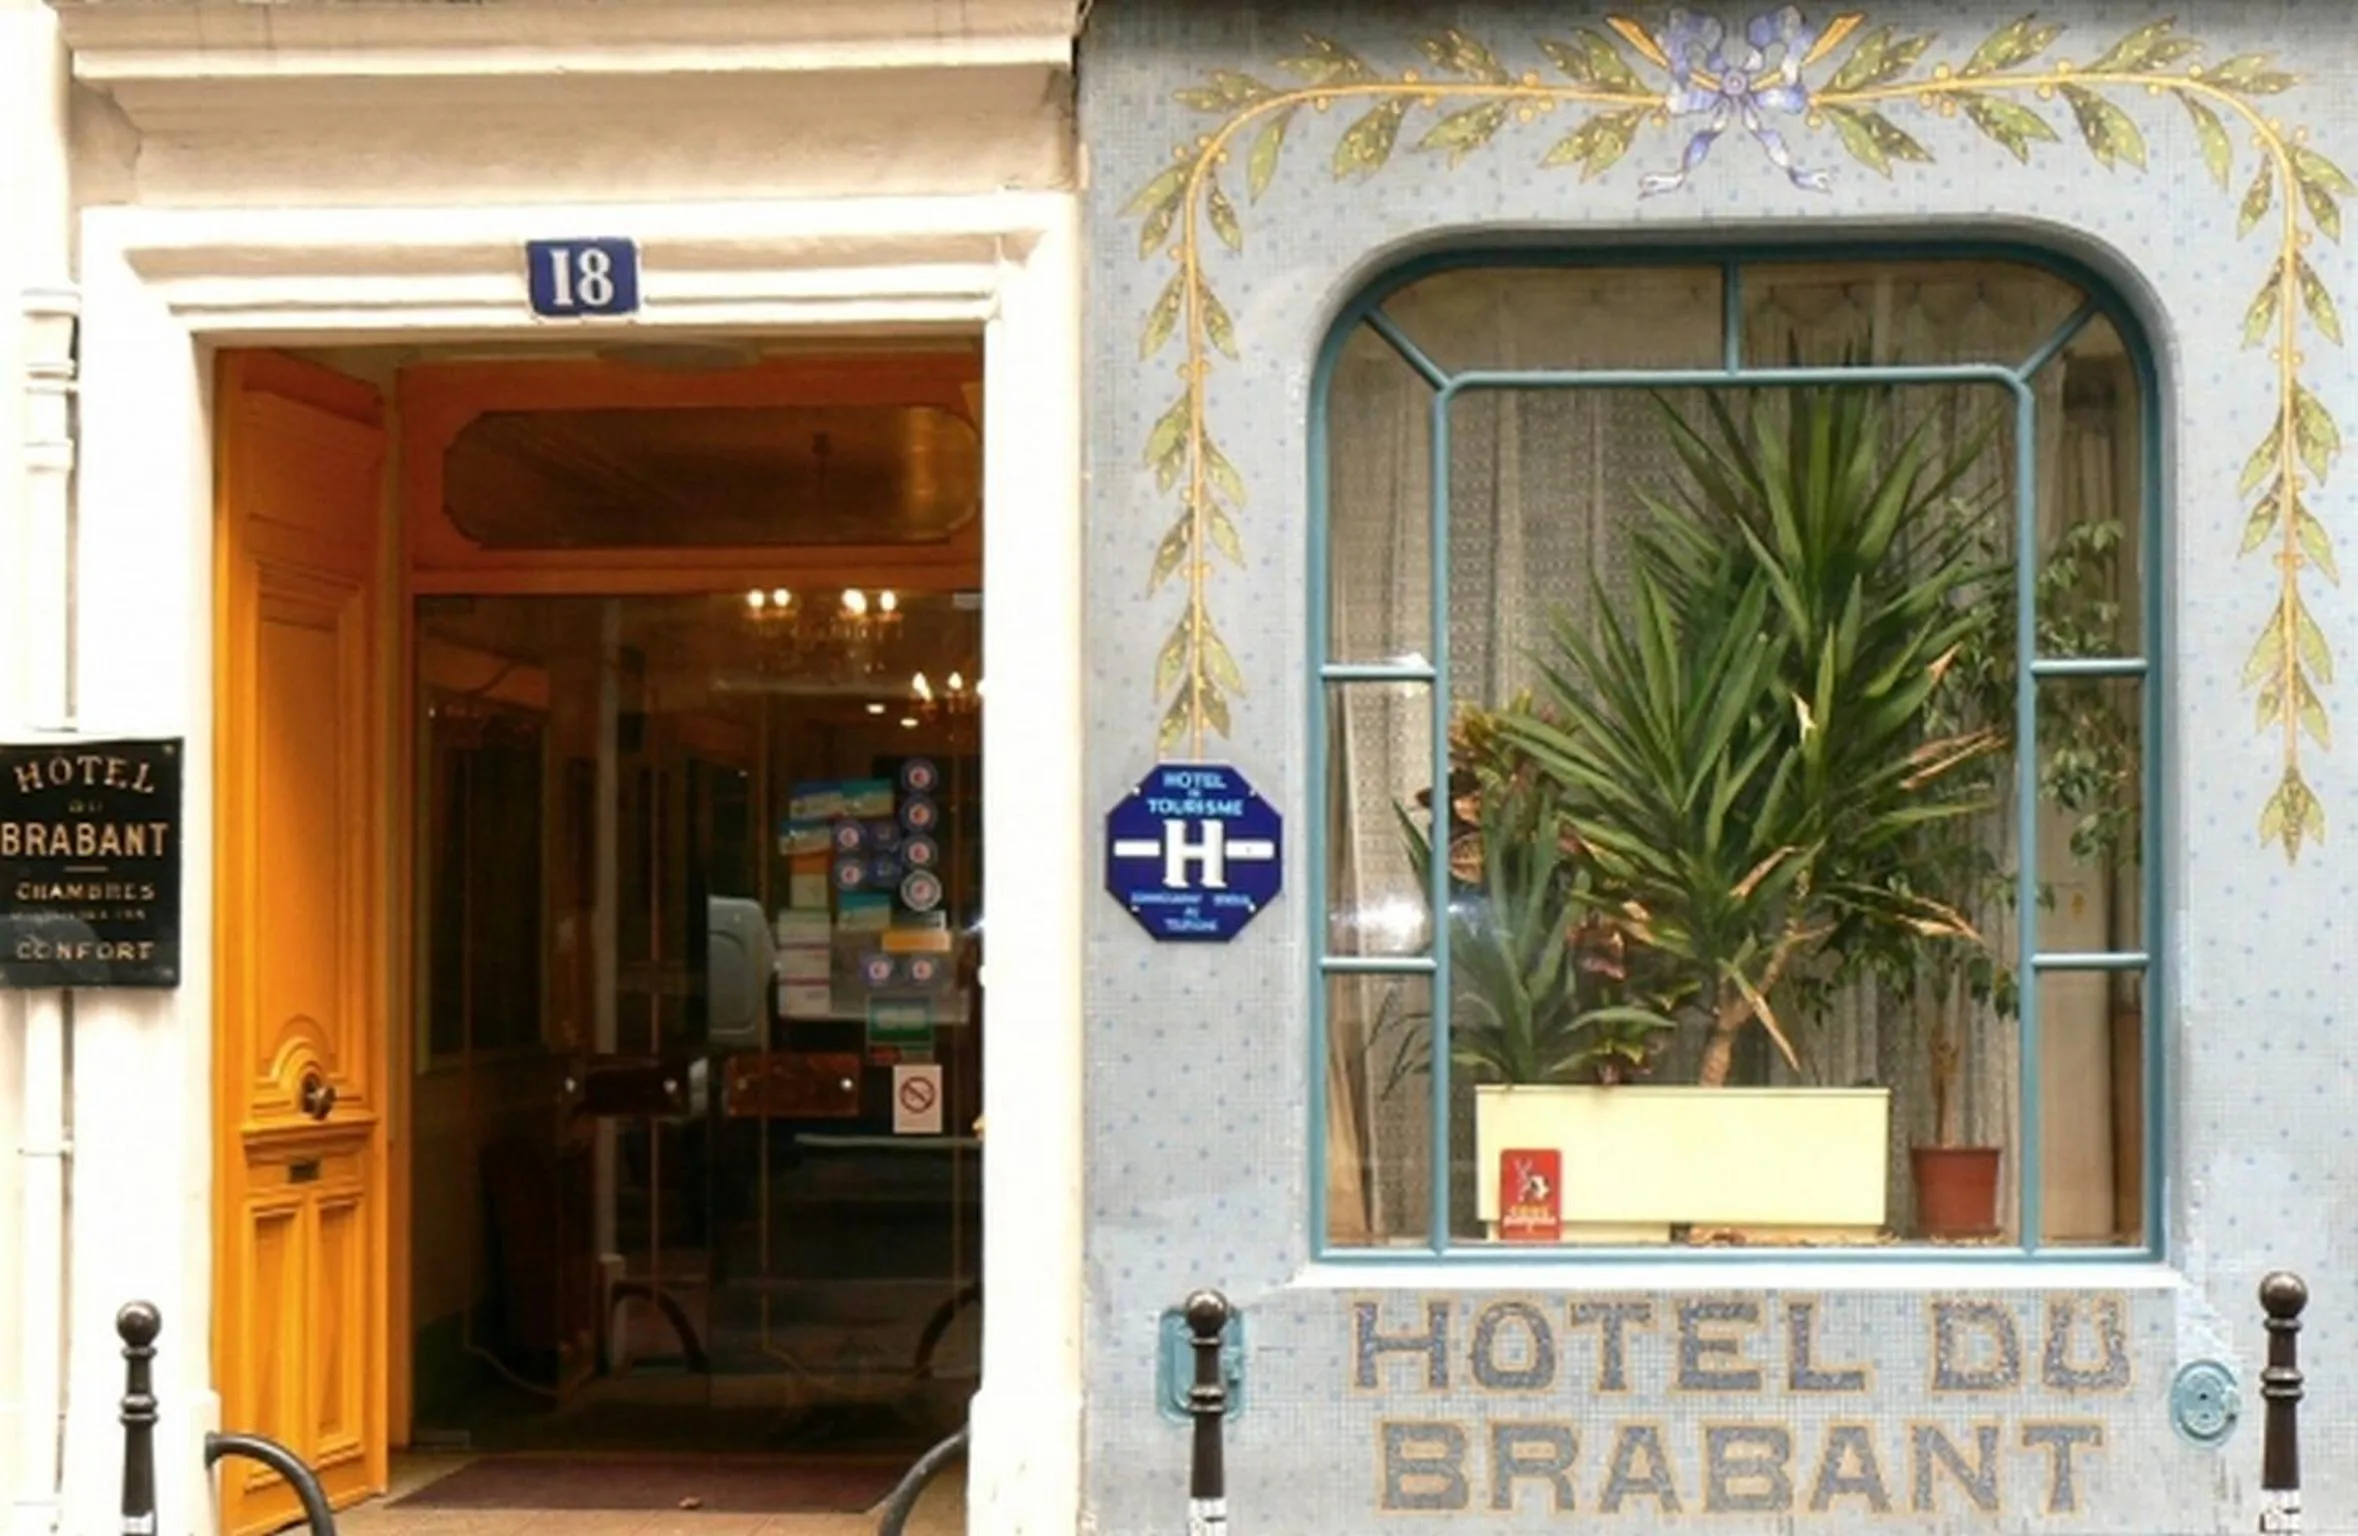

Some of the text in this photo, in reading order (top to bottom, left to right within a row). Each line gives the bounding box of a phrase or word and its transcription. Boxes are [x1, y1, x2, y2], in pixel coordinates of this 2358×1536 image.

[550, 247, 614, 307] 18
[1147, 798, 1243, 817] TOURISME
[0, 821, 169, 857] BRABANT
[1162, 818, 1228, 889] H
[15, 882, 156, 901] CHAMBRES
[16, 940, 154, 959] CONFORT
[1351, 1294, 2136, 1395] HOTEL DU
[1377, 1416, 2108, 1516] BRABANT
